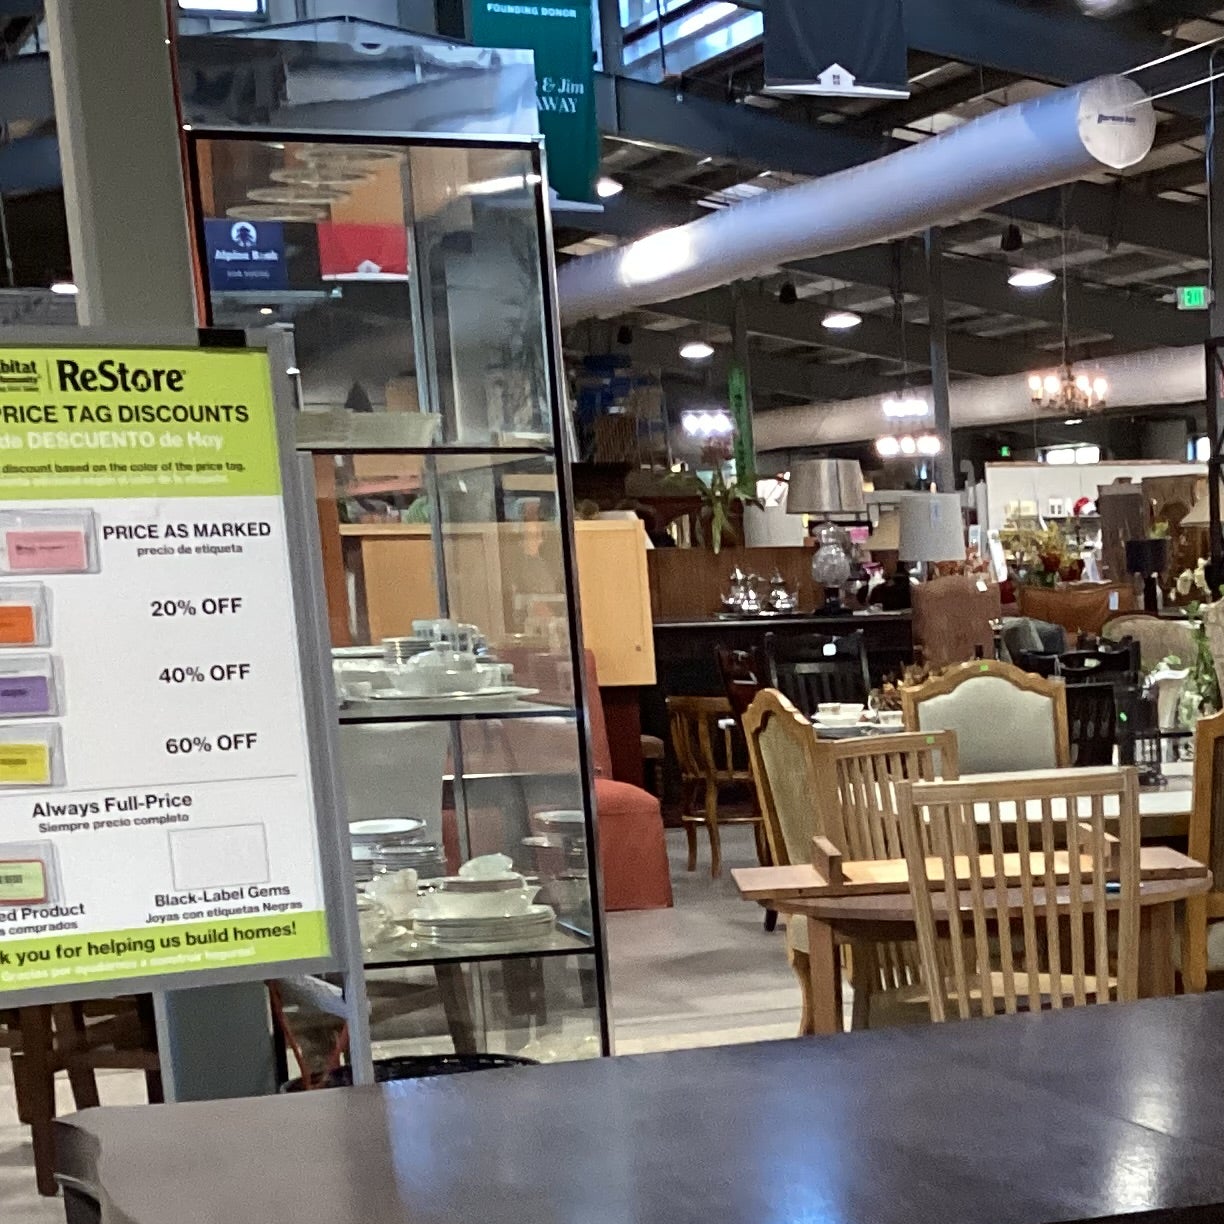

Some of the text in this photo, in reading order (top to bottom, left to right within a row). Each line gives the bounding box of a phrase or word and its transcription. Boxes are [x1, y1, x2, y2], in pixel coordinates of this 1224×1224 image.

[558, 78, 584, 94] Jim
[56, 359, 185, 393] ReStore
[0, 404, 249, 423] RICE TAG DISCOUNTS
[27, 431, 155, 449] DESCUENTO
[159, 431, 184, 447] de
[187, 431, 224, 450] Hoy
[109, 462, 127, 472] the
[103, 521, 271, 540] PRICE AS MARKED
[137, 543, 243, 557] precio de etiqueta
[151, 597, 243, 617] 20% OFF
[159, 663, 251, 683] 40% OFF
[165, 732, 258, 754] 60% OFF
[32, 793, 193, 818] Always Full-Price
[38, 812, 189, 833] Siempre precio completo
[154, 885, 291, 907] Black-Label Gems
[21, 903, 86, 920] Product
[145, 900, 303, 924] Joyas con etiquetas Negras
[8, 920, 79, 934] comprados
[16, 949, 51, 967] you
[56, 944, 82, 958] for
[87, 937, 155, 956] helping
[160, 936, 181, 948] us
[185, 928, 229, 946] build
[233, 920, 297, 941] homes!
